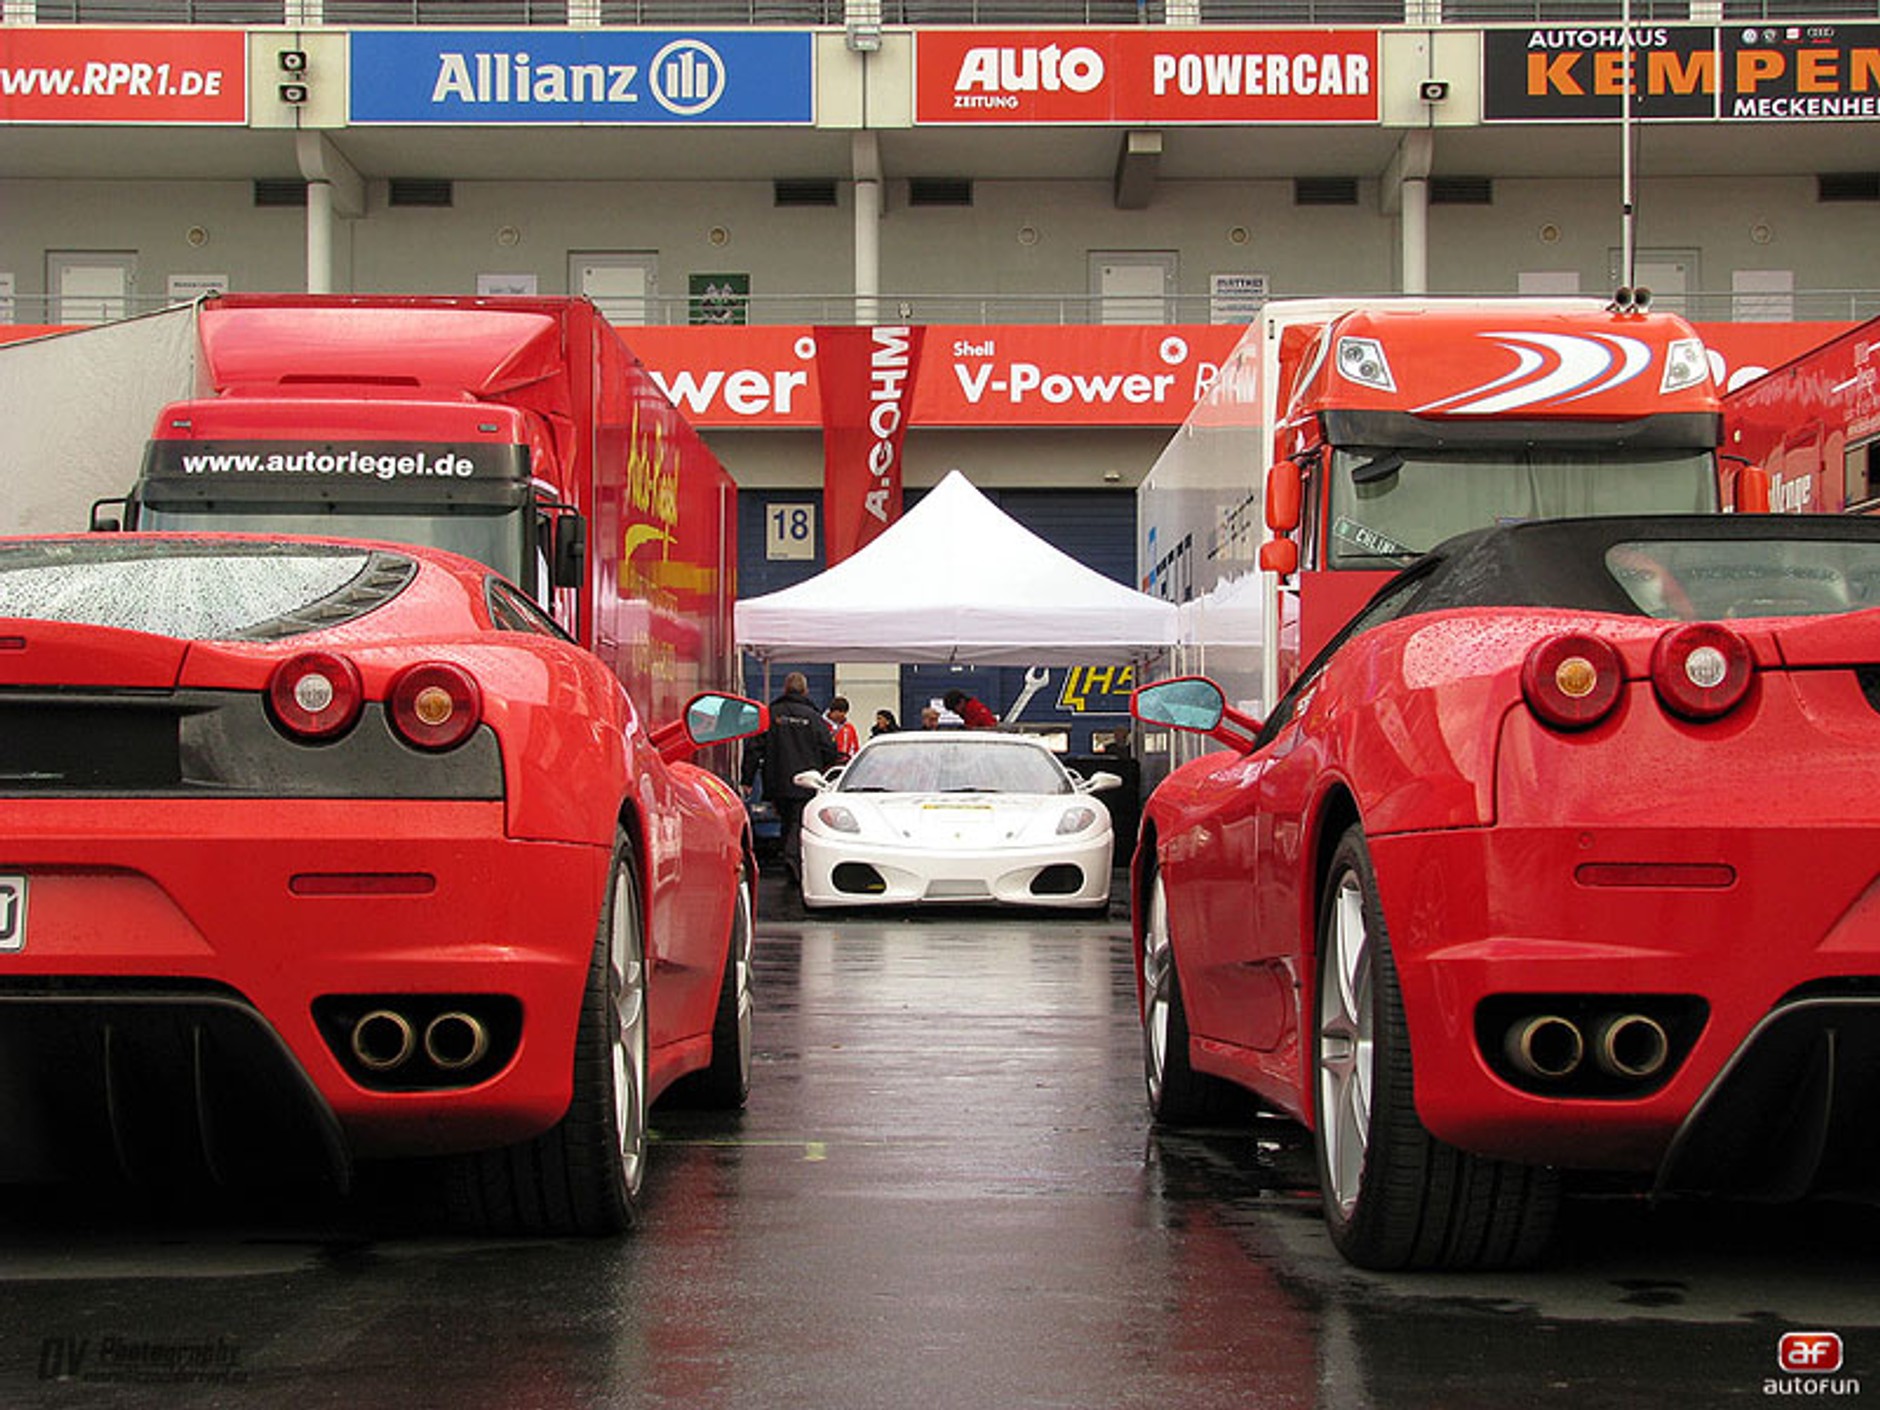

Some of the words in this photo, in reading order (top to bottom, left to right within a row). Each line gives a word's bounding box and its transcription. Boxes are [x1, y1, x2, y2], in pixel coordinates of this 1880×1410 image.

[1528, 28, 1668, 48] AUTOHAUS
[432, 53, 638, 102] Allianz
[1153, 54, 1370, 96] POWERCAR
[953, 96, 1018, 109] ZEITUNG
[953, 340, 995, 357] Shell
[953, 363, 1175, 403] V-Power
[182, 451, 474, 479] www.autoriegel.de
[773, 508, 809, 541] 18
